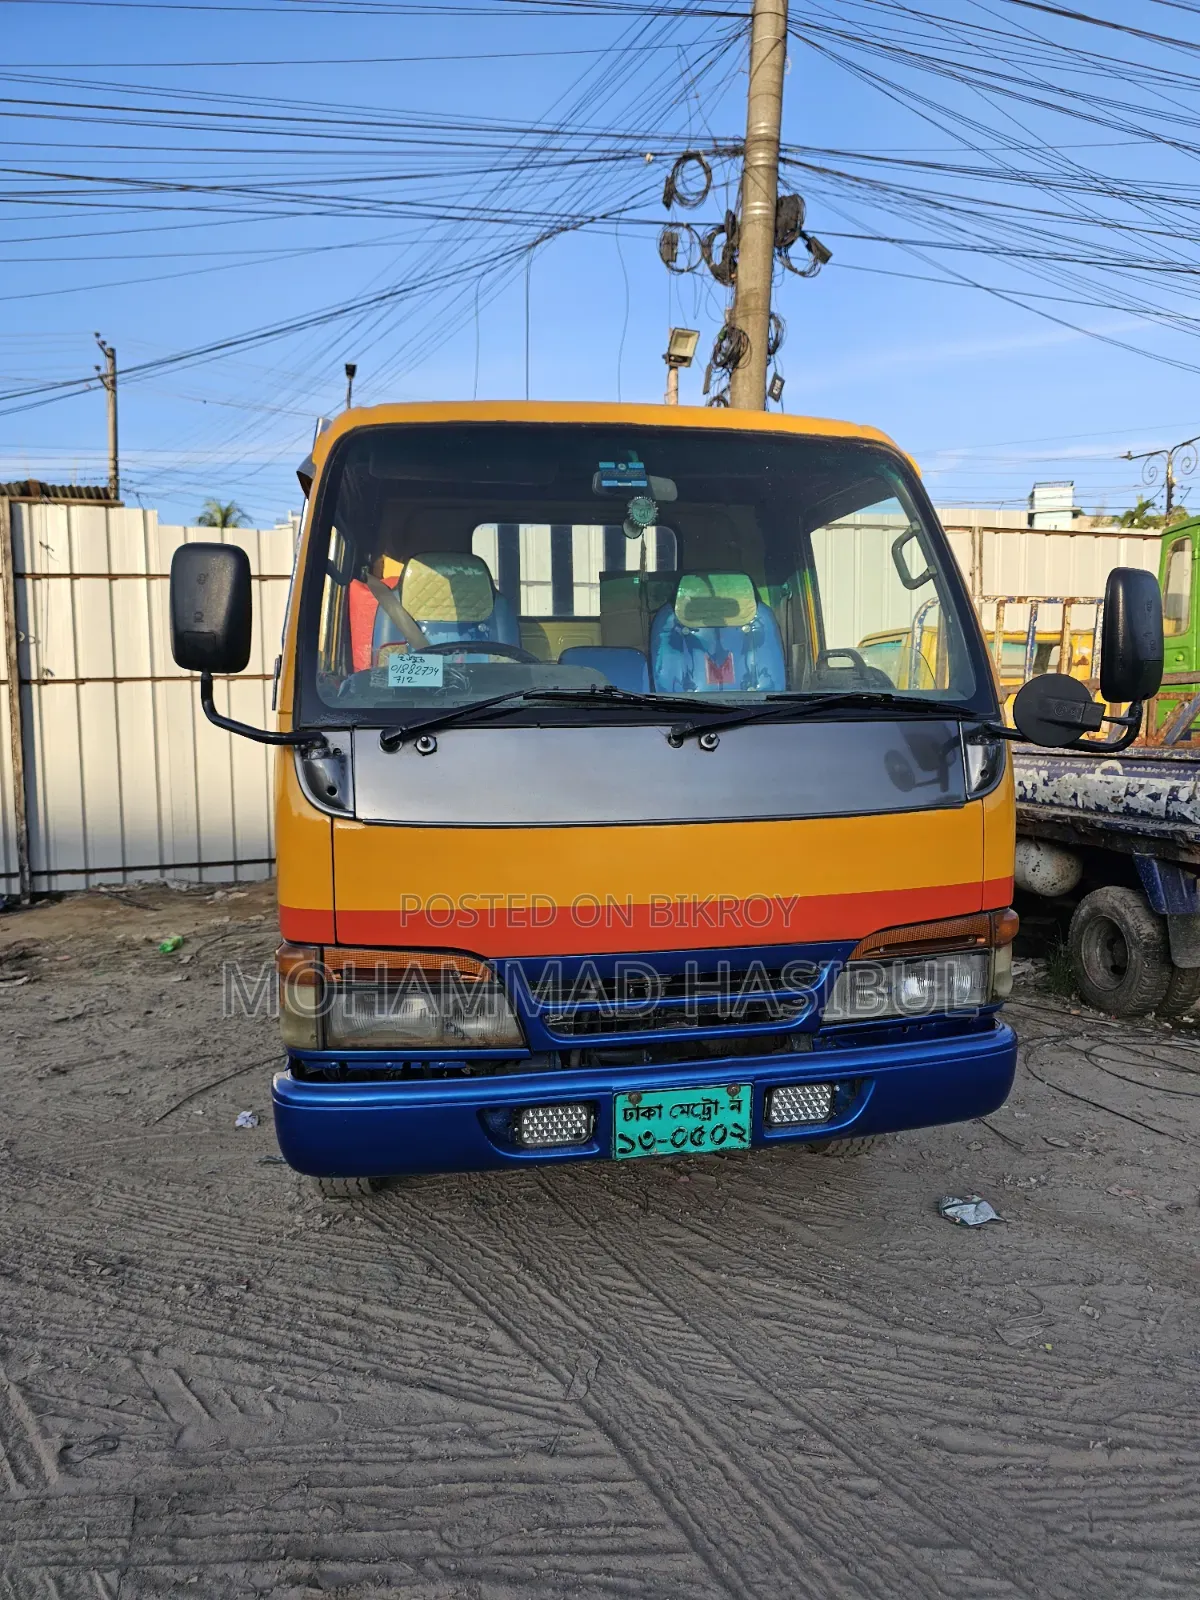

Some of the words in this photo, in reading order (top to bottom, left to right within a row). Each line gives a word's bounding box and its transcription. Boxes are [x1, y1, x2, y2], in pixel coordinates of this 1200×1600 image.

[393, 675, 418, 684] 712
[621, 1102, 664, 1122] ঢাকা
[616, 1122, 748, 1154] ১৩-০৫০২
